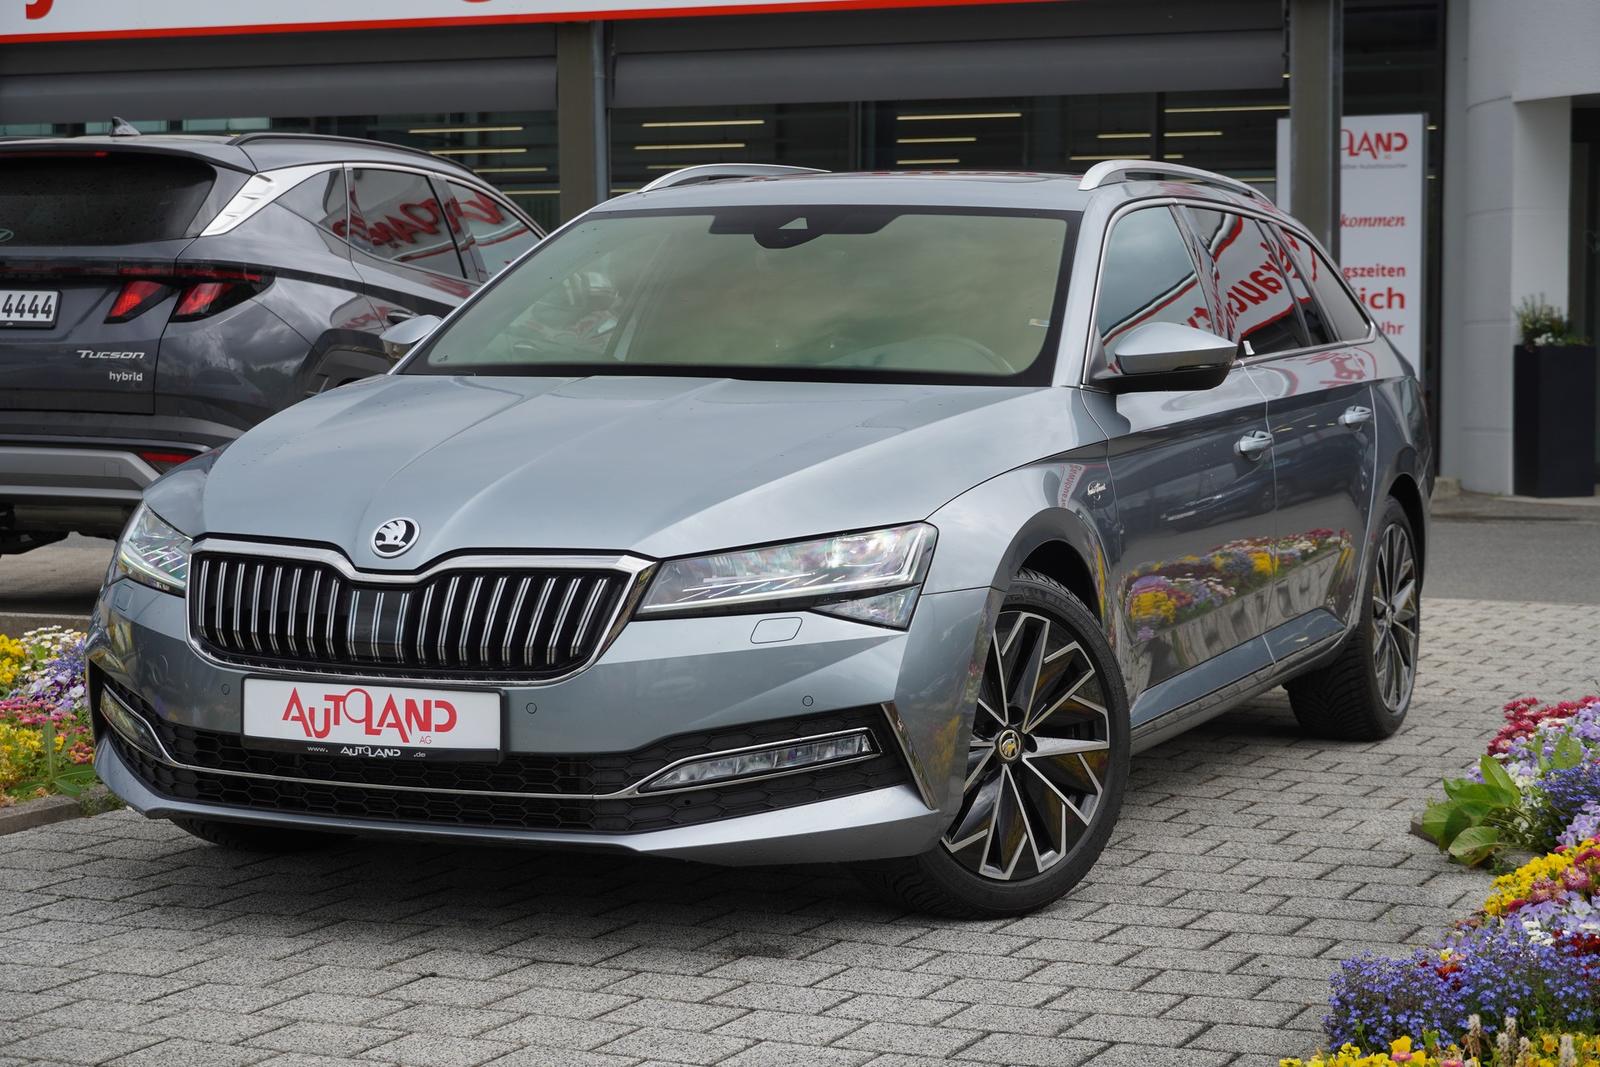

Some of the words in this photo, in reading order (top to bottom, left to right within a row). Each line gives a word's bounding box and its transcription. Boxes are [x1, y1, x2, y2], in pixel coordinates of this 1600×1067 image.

[2, 294, 52, 318] 4444
[109, 371, 143, 382] hybrid
[419, 735, 433, 744] AG
